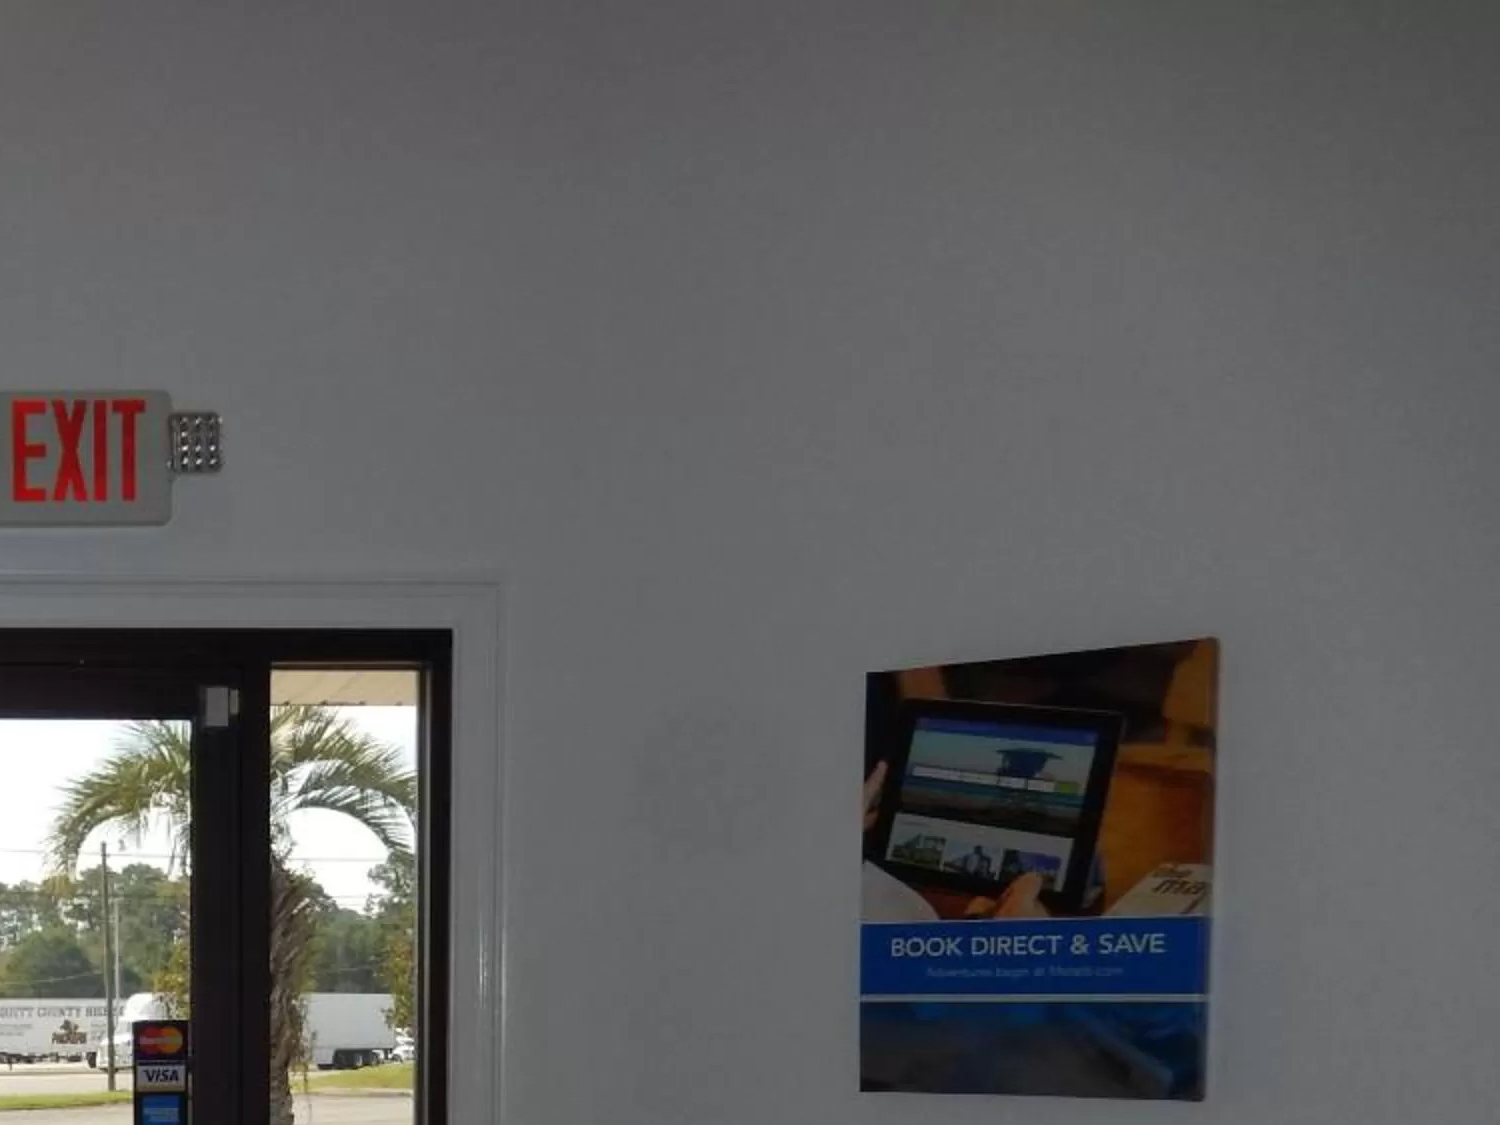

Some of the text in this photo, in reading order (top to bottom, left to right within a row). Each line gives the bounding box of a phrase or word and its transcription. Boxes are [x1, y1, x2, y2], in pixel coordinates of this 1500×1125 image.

[10, 399, 146, 502] EXIT
[890, 932, 1167, 957] BOOK DIRECT & SAVE
[143, 1069, 180, 1083] VISA
